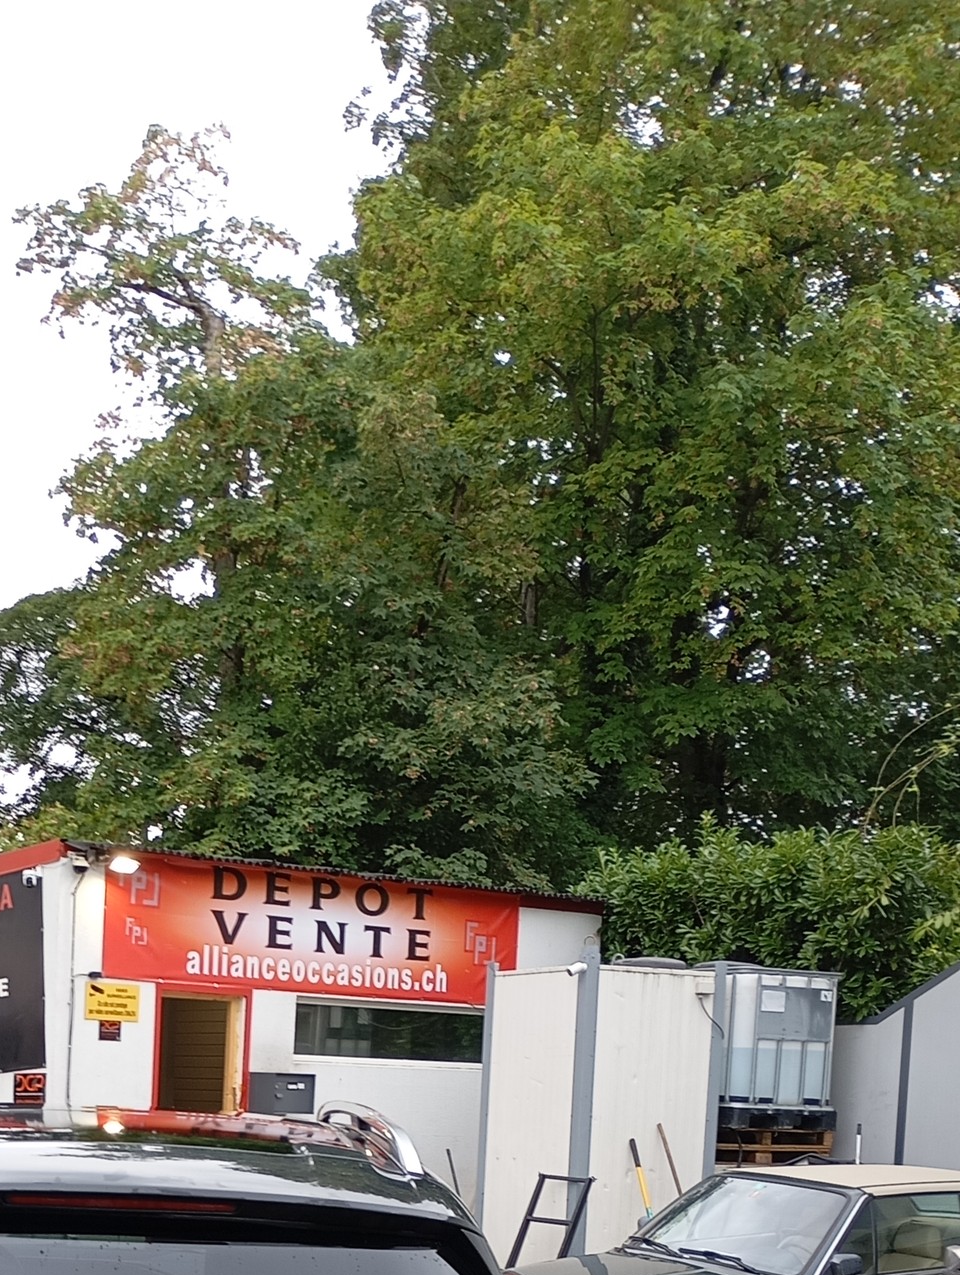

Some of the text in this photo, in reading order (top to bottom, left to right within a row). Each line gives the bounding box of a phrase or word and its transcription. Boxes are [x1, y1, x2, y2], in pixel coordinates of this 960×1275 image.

[210, 865, 433, 921] DEPOT
[211, 909, 432, 962] VENTE
[186, 944, 448, 993] allianceoccasions.ch
